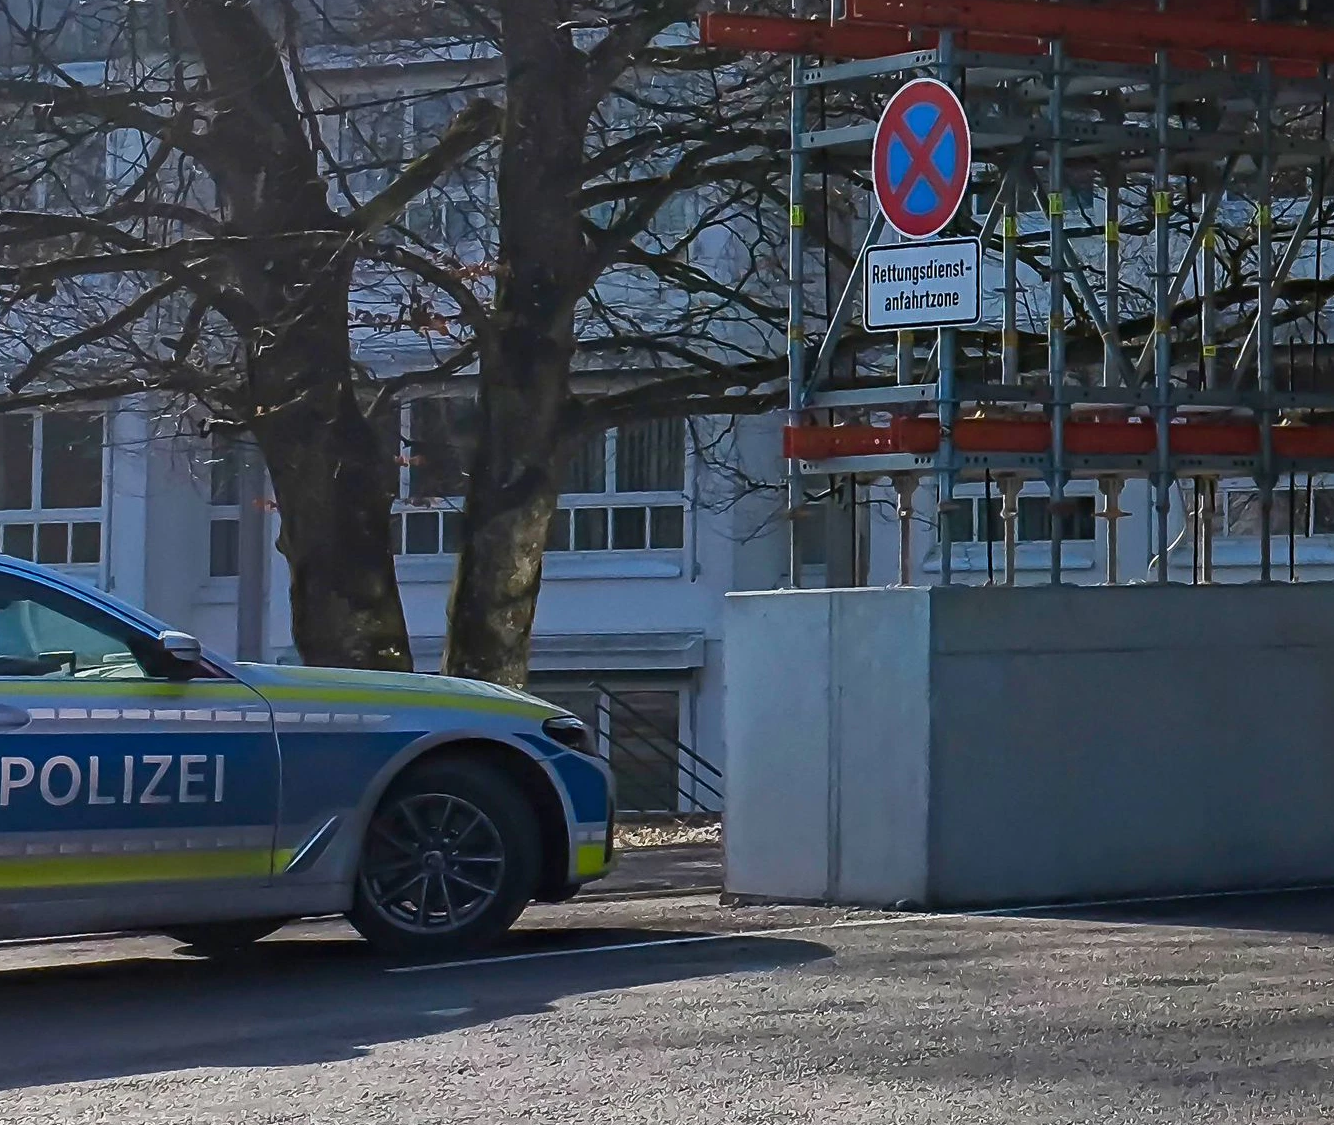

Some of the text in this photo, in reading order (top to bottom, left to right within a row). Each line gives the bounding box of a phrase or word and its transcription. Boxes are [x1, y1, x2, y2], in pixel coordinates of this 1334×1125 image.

[872, 258, 972, 286] Rettungsdienst-
[884, 289, 959, 312] anfahrtzone
[0, 754, 225, 807] POLIZEI
